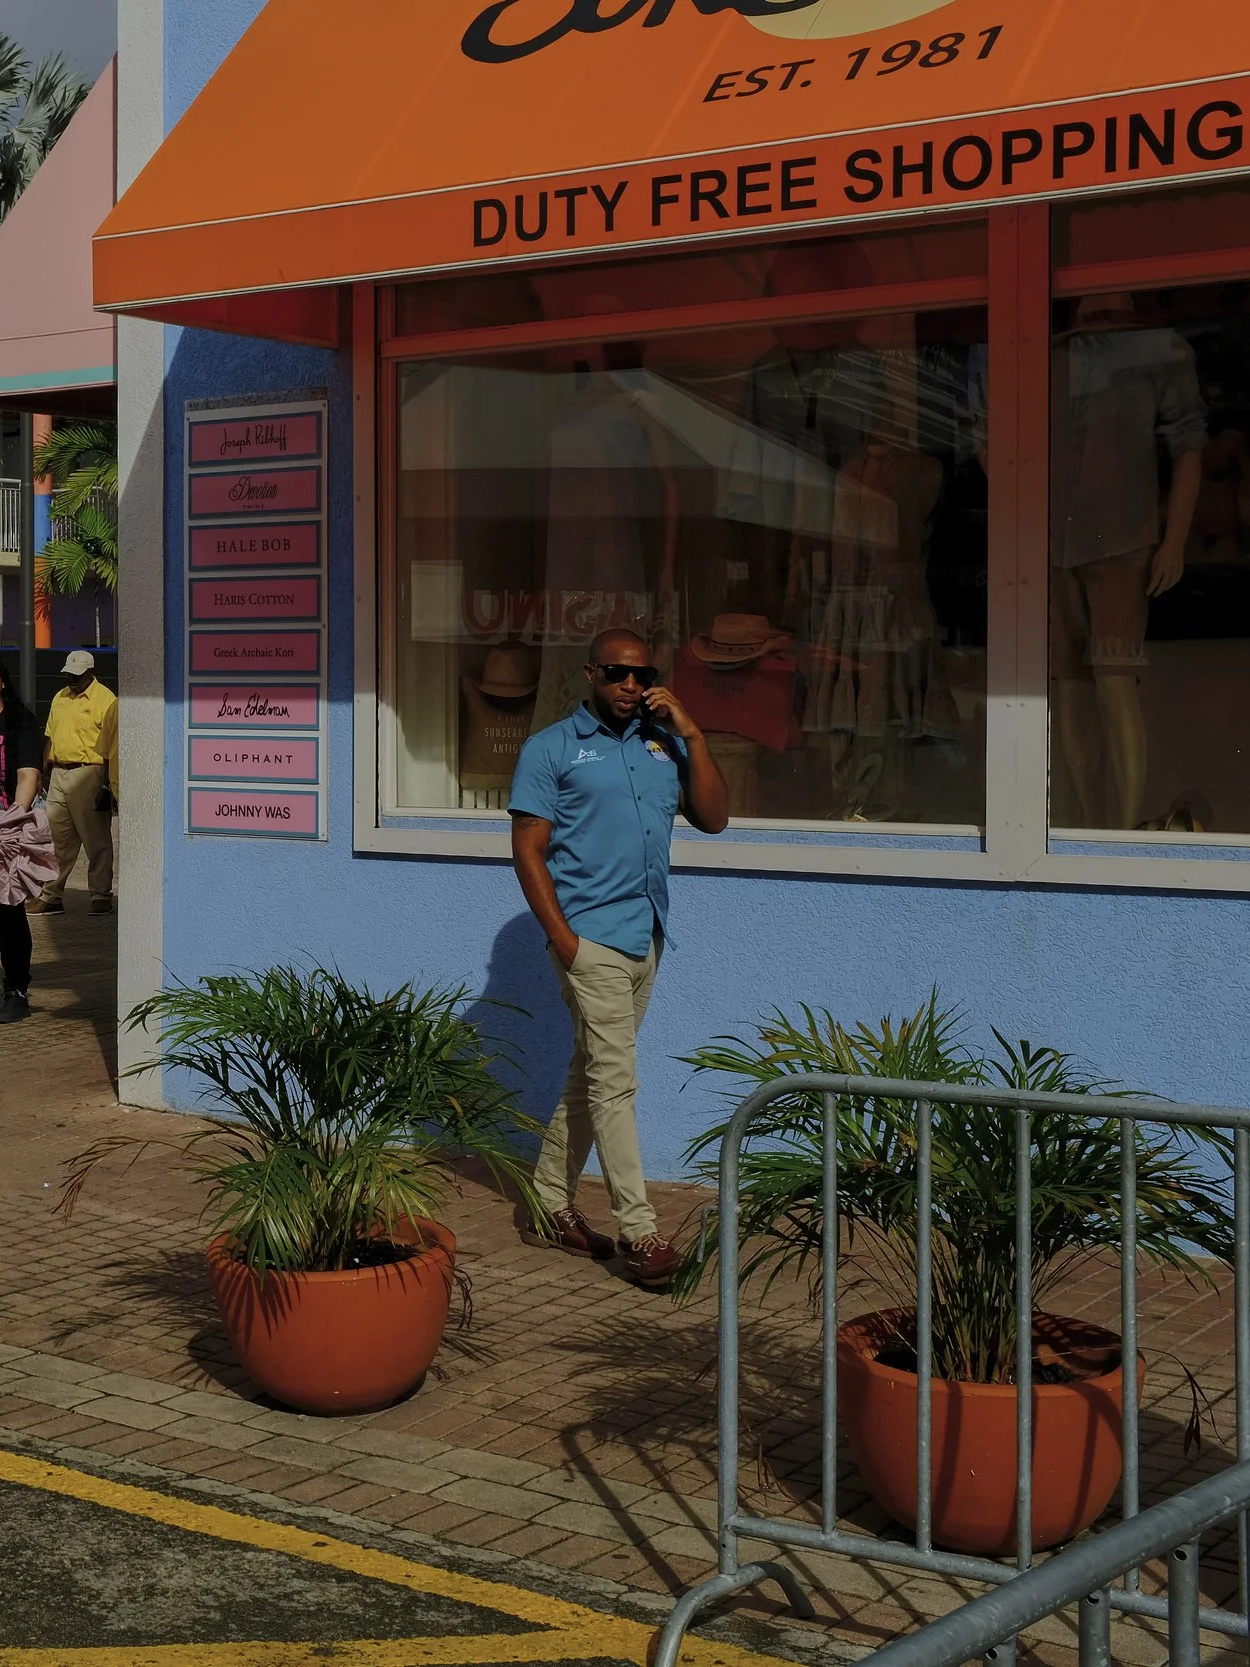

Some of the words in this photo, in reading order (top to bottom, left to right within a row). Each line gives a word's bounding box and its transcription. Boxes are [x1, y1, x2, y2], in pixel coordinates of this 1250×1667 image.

[702, 58, 816, 103] EST.
[843, 25, 1004, 82] 1981
[472, 180, 629, 248] DUTY
[651, 157, 818, 227] FREE
[844, 101, 1245, 204] SHOPPING
[220, 426, 251, 456] Joseph
[217, 540, 257, 553] HALE
[261, 538, 291, 552] BOB
[213, 647, 238, 657] Greek
[241, 647, 273, 657] Archaic
[275, 647, 294, 657] Kori
[217, 692, 242, 718] Sam
[492, 743, 523, 754] ANTIG
[213, 753, 294, 764] OLIPHANT
[215, 804, 263, 818] JOHNNY
[264, 806, 291, 820] WAS
